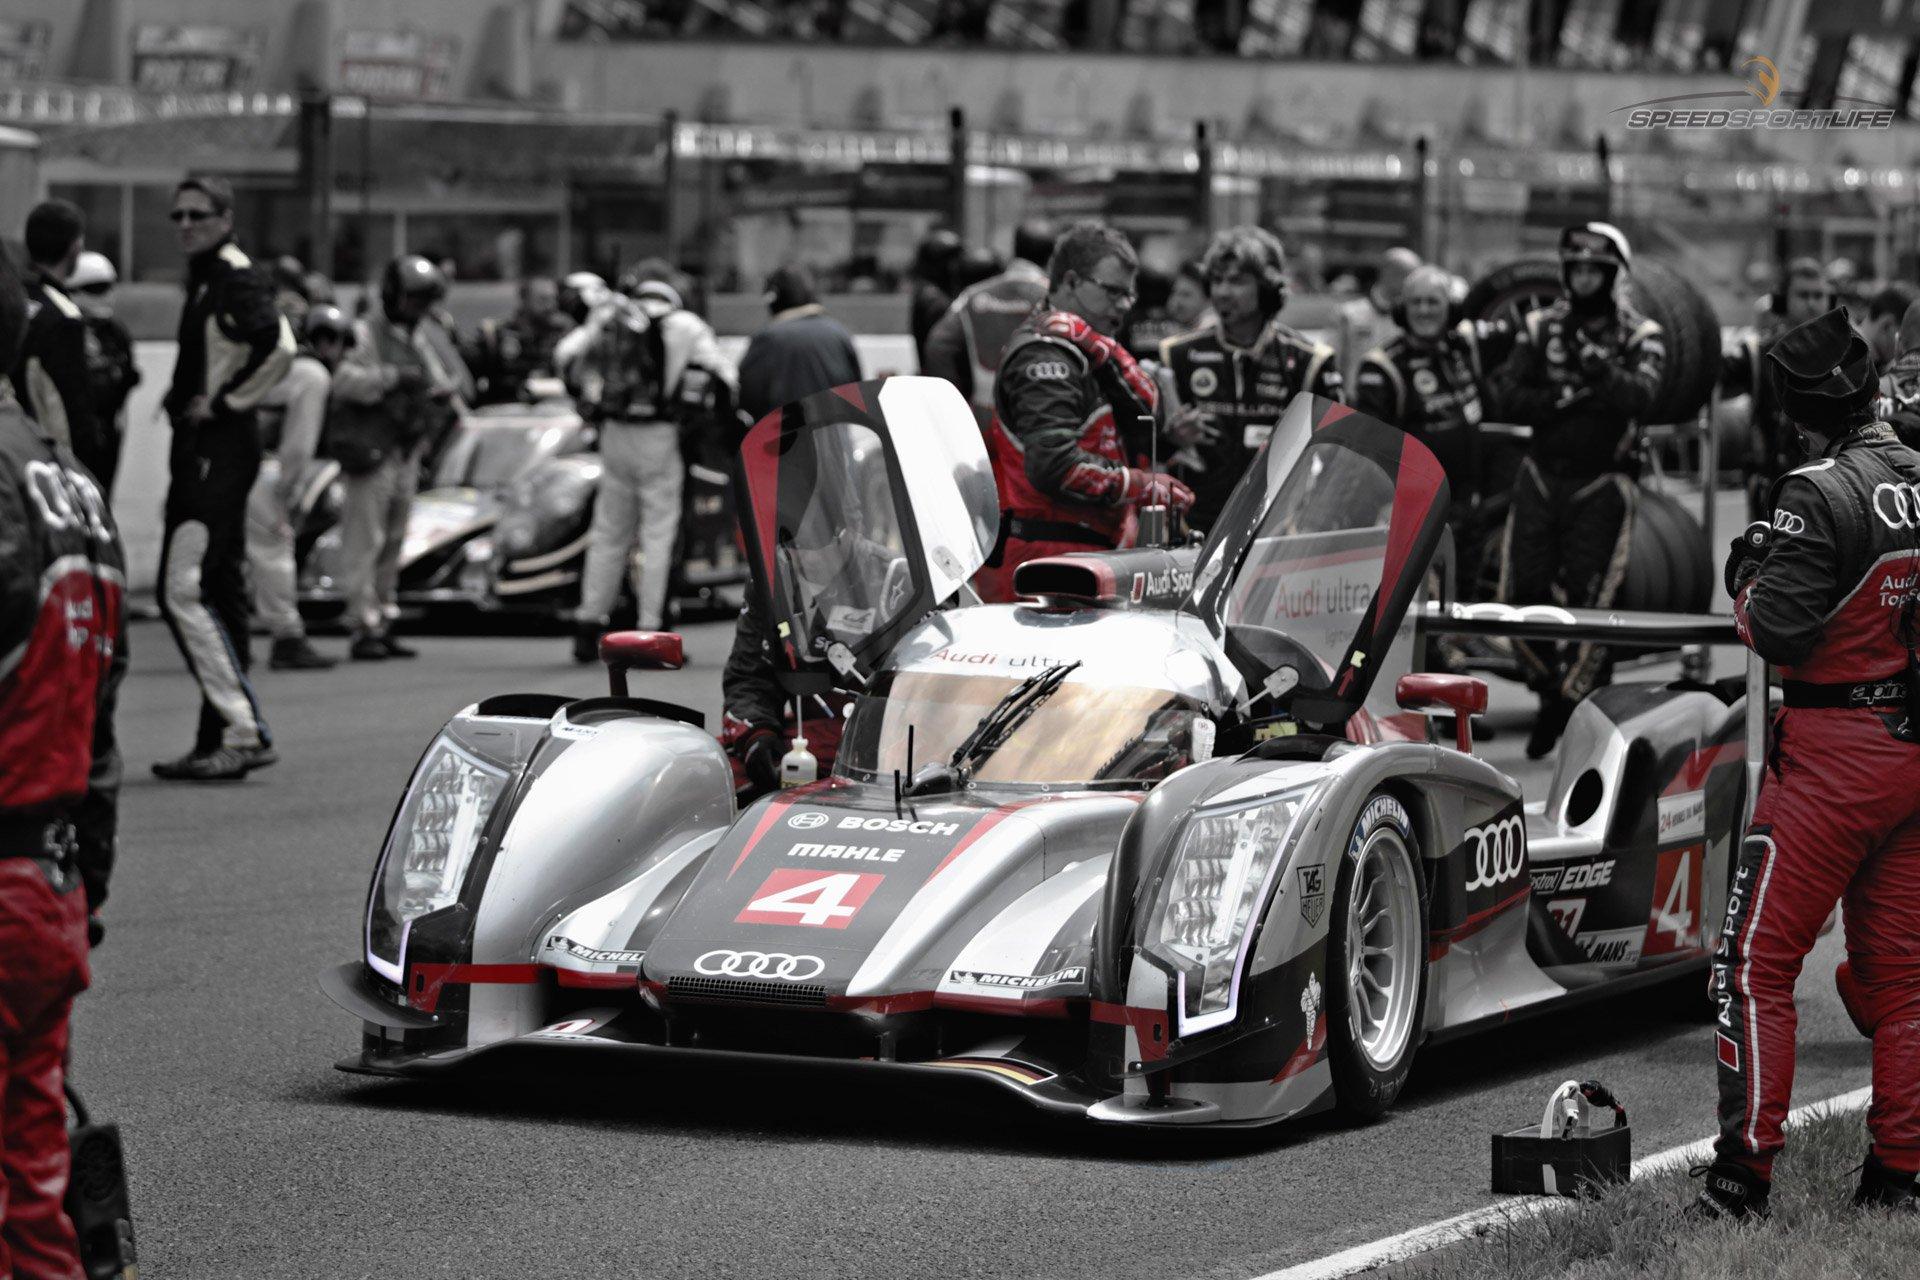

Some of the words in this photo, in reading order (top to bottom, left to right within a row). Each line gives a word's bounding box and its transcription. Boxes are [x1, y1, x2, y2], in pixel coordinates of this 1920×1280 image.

[1146, 569, 1171, 596] Audi
[1275, 577, 1321, 620] Audi
[1326, 575, 1371, 613] ultra
[930, 649, 998, 665] Audi
[1009, 656, 1080, 668] ultr
[837, 816, 960, 836] BOSCH
[1361, 798, 1408, 838] MICHELIN
[787, 842, 906, 863] MAHLE
[1559, 860, 1616, 891] EDGE
[747, 873, 857, 925] 4
[1656, 851, 1692, 948] 4
[1717, 865, 1749, 958] Sport
[979, 968, 1080, 987] MICHELIN
[1717, 962, 1733, 1028] Audi
